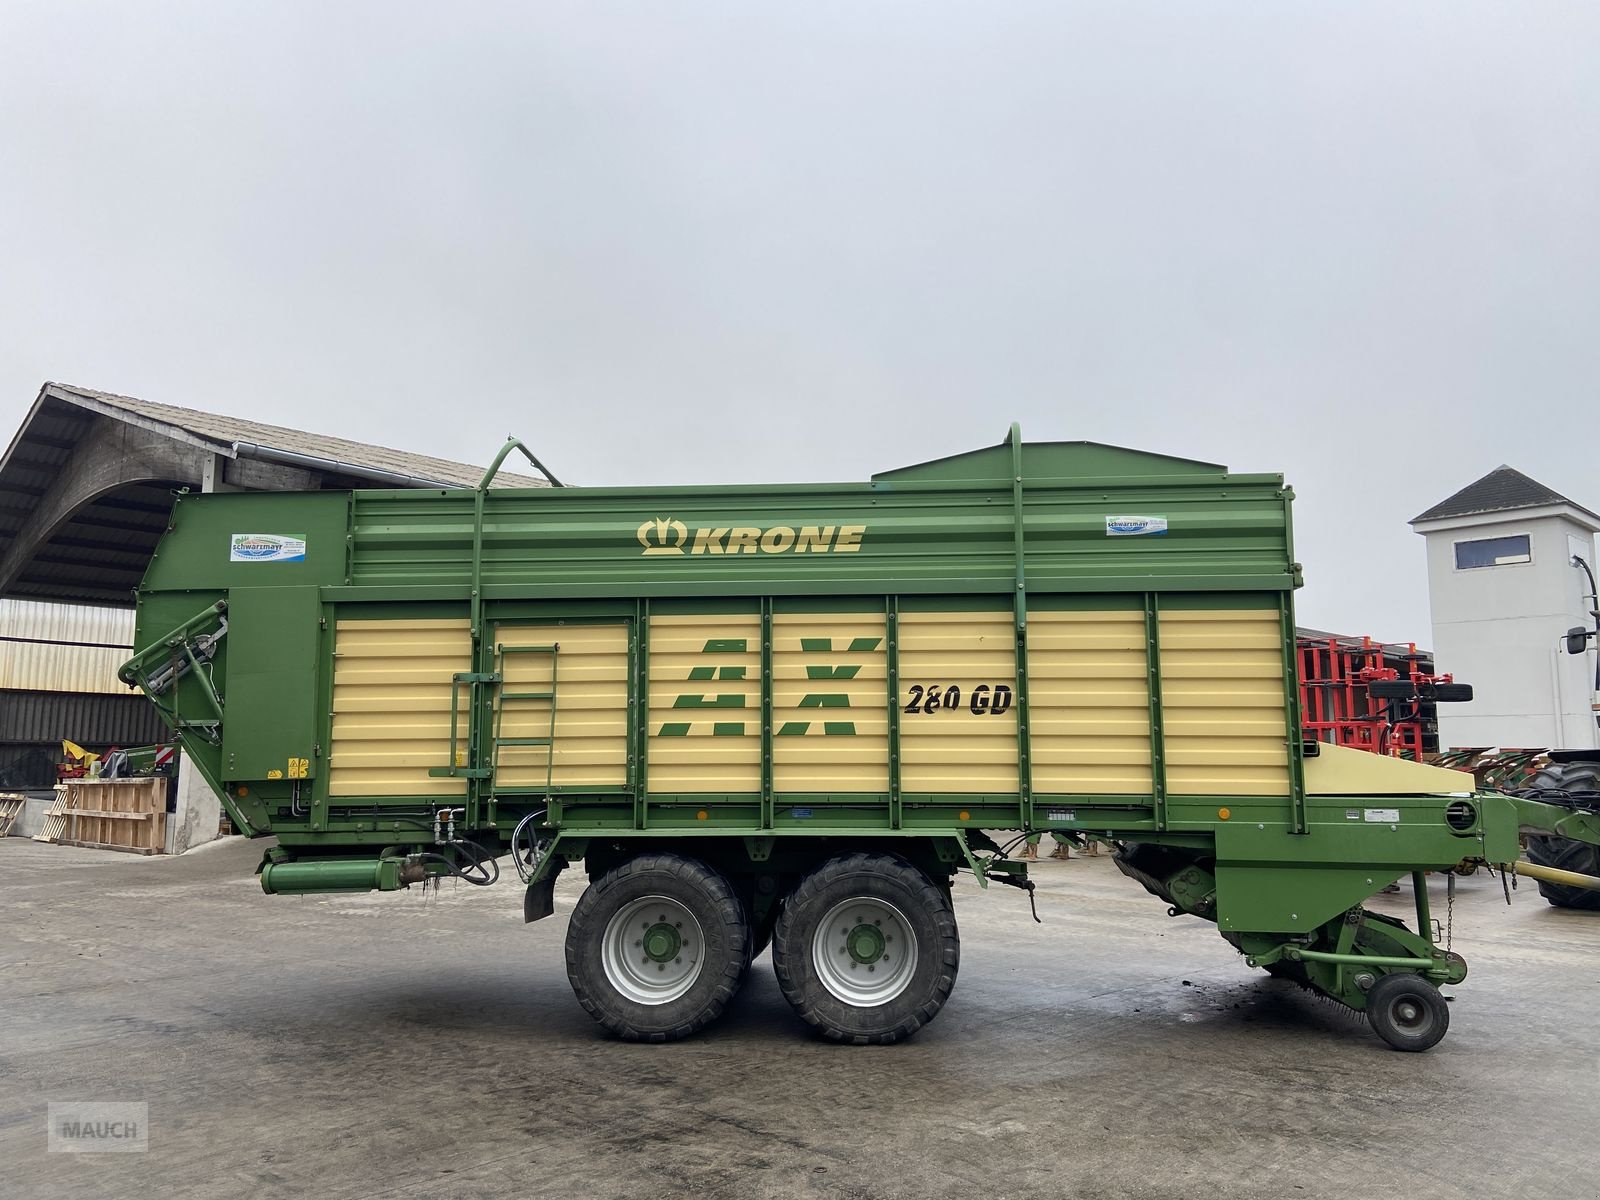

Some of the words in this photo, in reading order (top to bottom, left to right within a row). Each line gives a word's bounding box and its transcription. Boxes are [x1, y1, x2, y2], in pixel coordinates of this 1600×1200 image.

[232, 543, 283, 551] schwarzmayr
[691, 525, 867, 555] KRONE
[904, 684, 961, 715] 280
[970, 684, 1012, 716] GD
